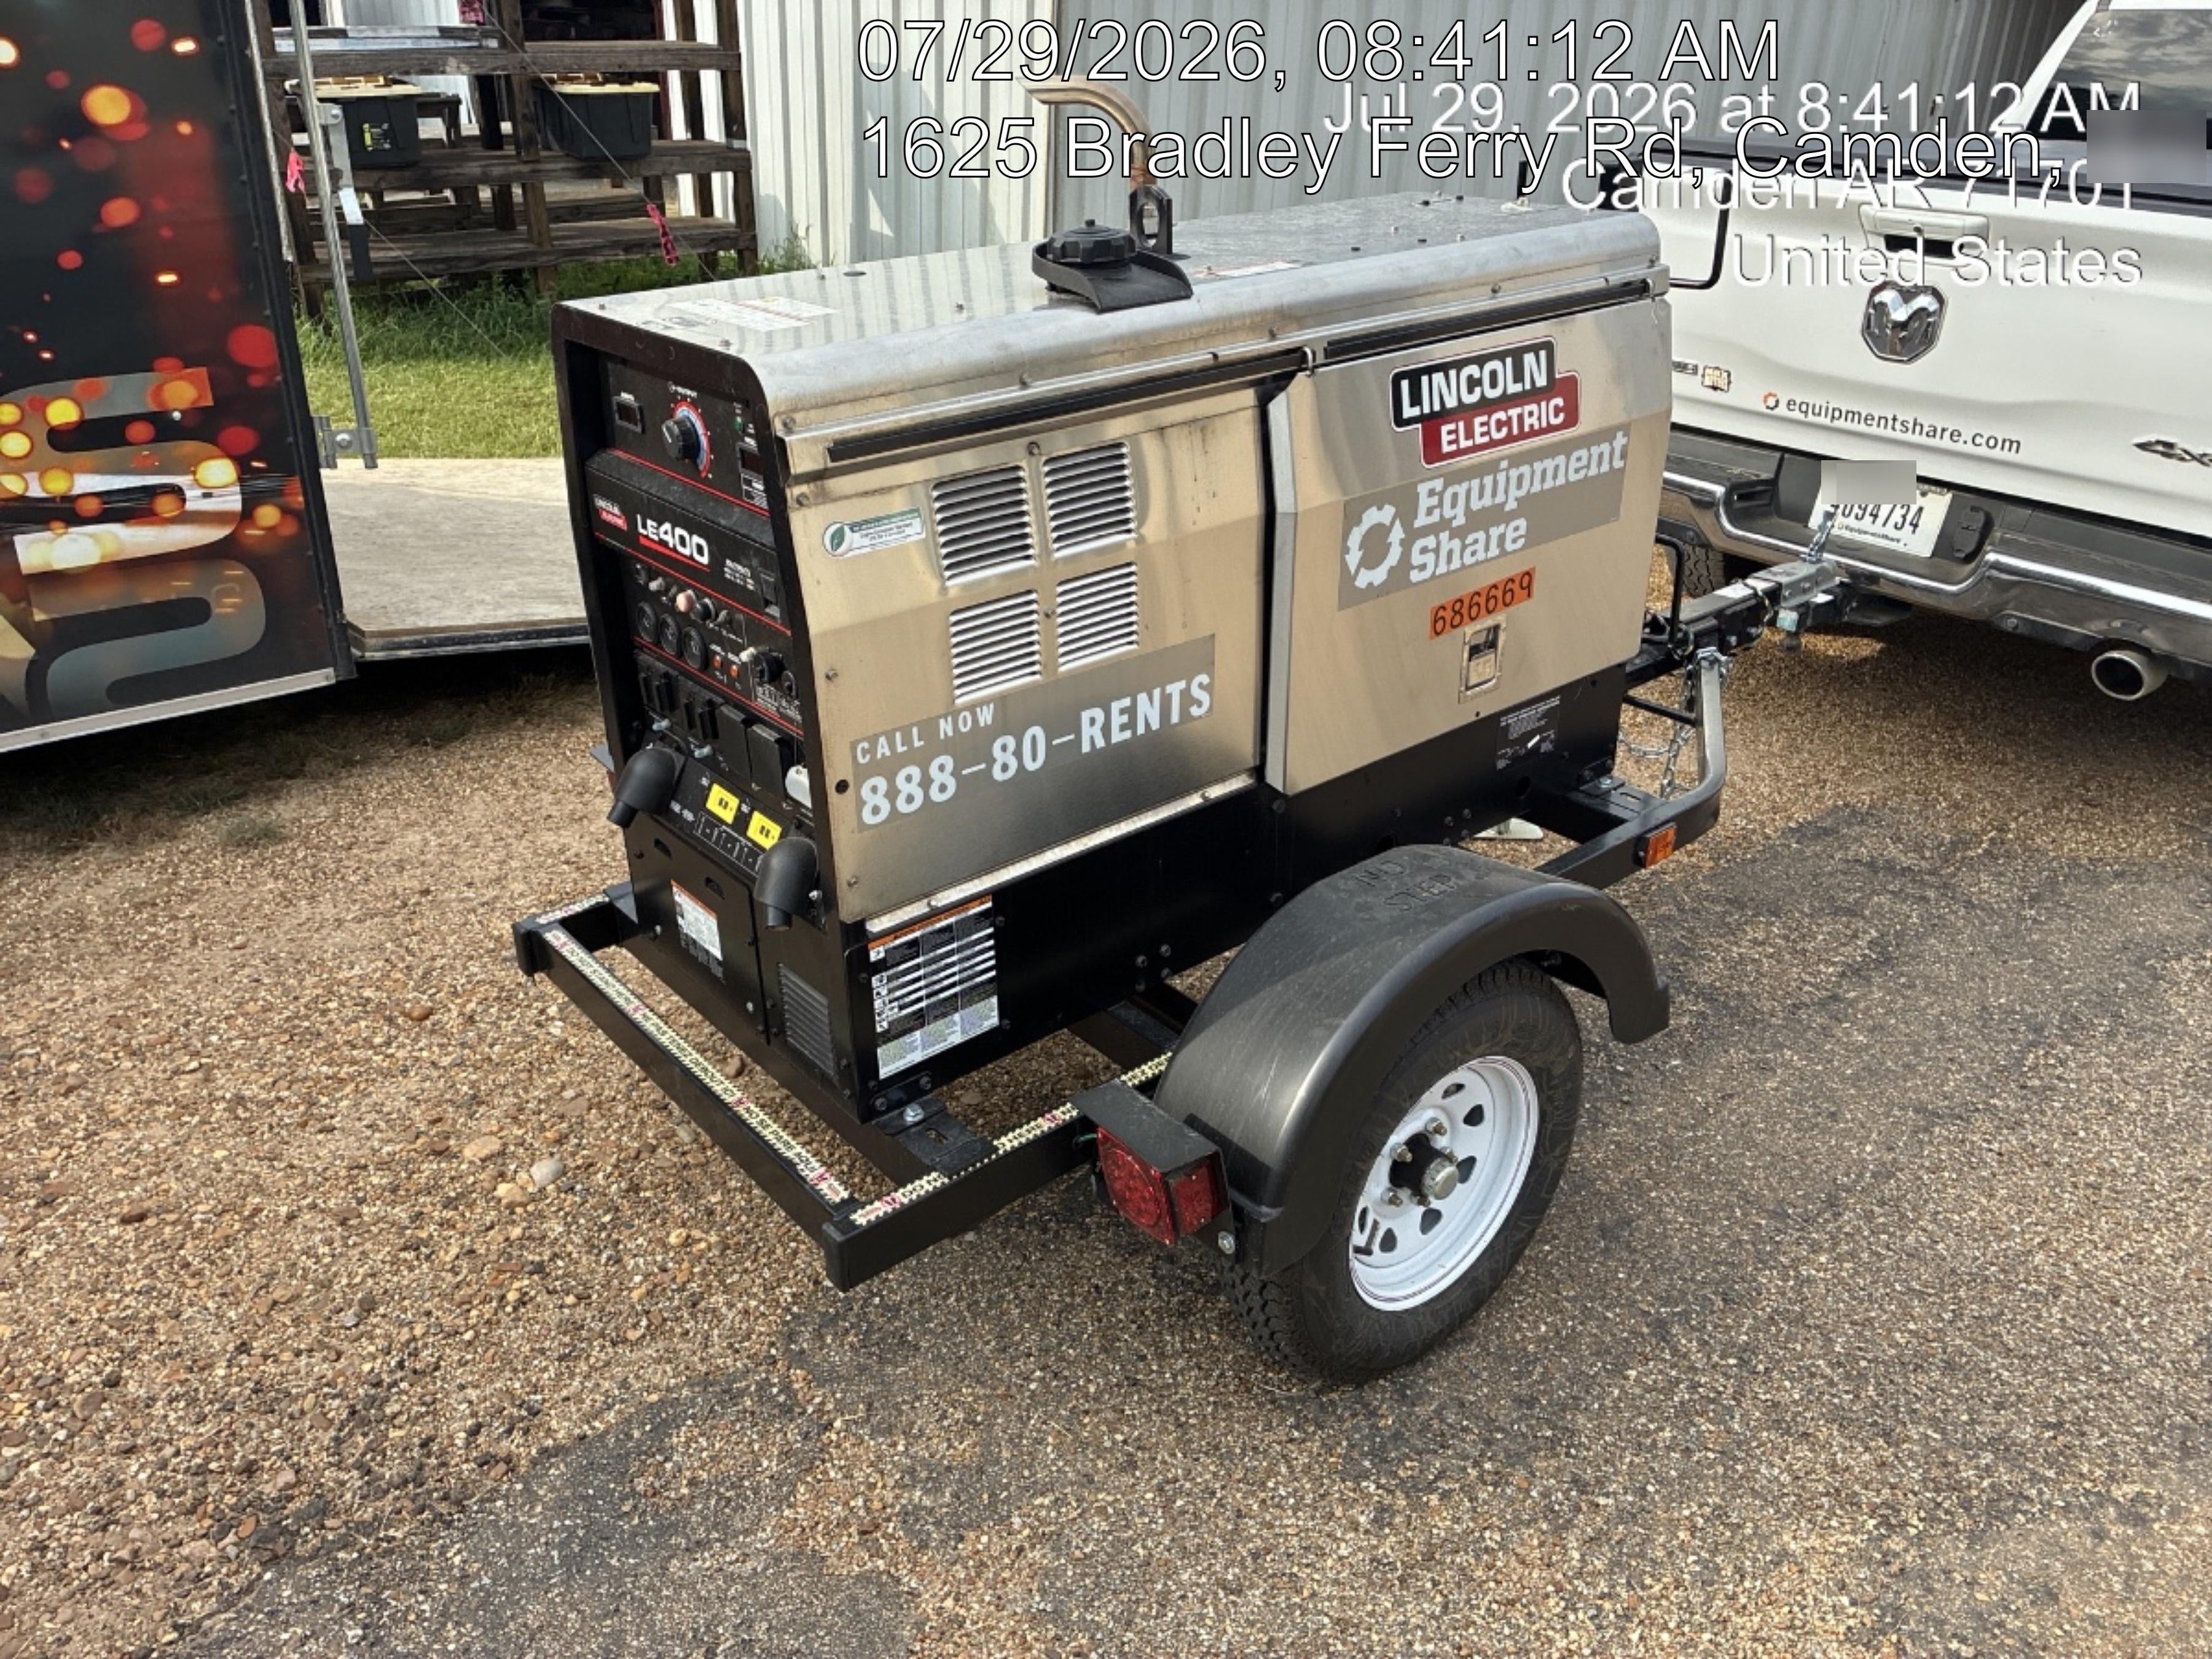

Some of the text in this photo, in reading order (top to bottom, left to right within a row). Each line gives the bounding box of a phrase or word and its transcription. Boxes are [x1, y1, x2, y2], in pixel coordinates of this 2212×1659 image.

[1400, 350, 1548, 420] LINCOLN
[1440, 398, 1566, 454] ELECTRIC
[1786, 398, 2022, 455] equipmentshare.com
[1413, 431, 1628, 527] Equipment
[637, 514, 709, 565] LE400
[1410, 517, 1528, 584] Share
[1829, 503, 1924, 535] 094734
[1432, 571, 1534, 637] 686669
[857, 703, 995, 765] CALL NOW
[860, 673, 1211, 826] 888-80-RENTS
